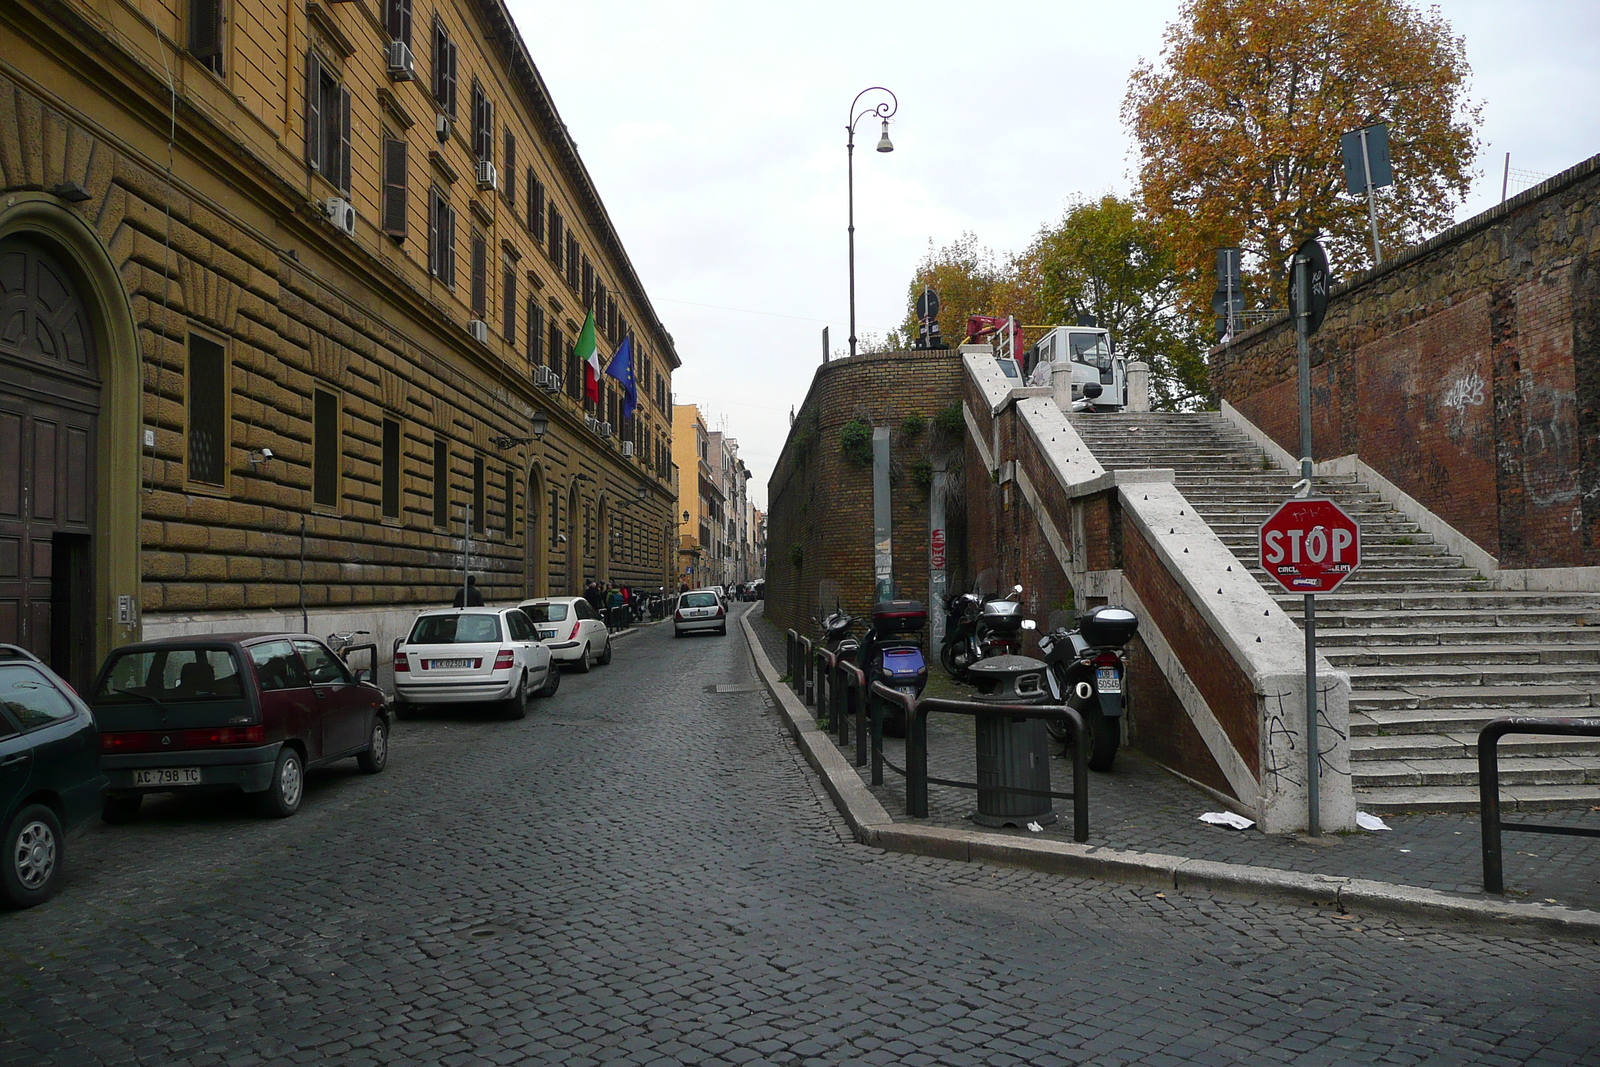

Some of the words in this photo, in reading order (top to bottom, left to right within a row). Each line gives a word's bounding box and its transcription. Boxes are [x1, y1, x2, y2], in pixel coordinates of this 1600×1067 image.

[1265, 528, 1352, 564] STOP
[137, 771, 151, 784] AC
[157, 770, 179, 783] 798
